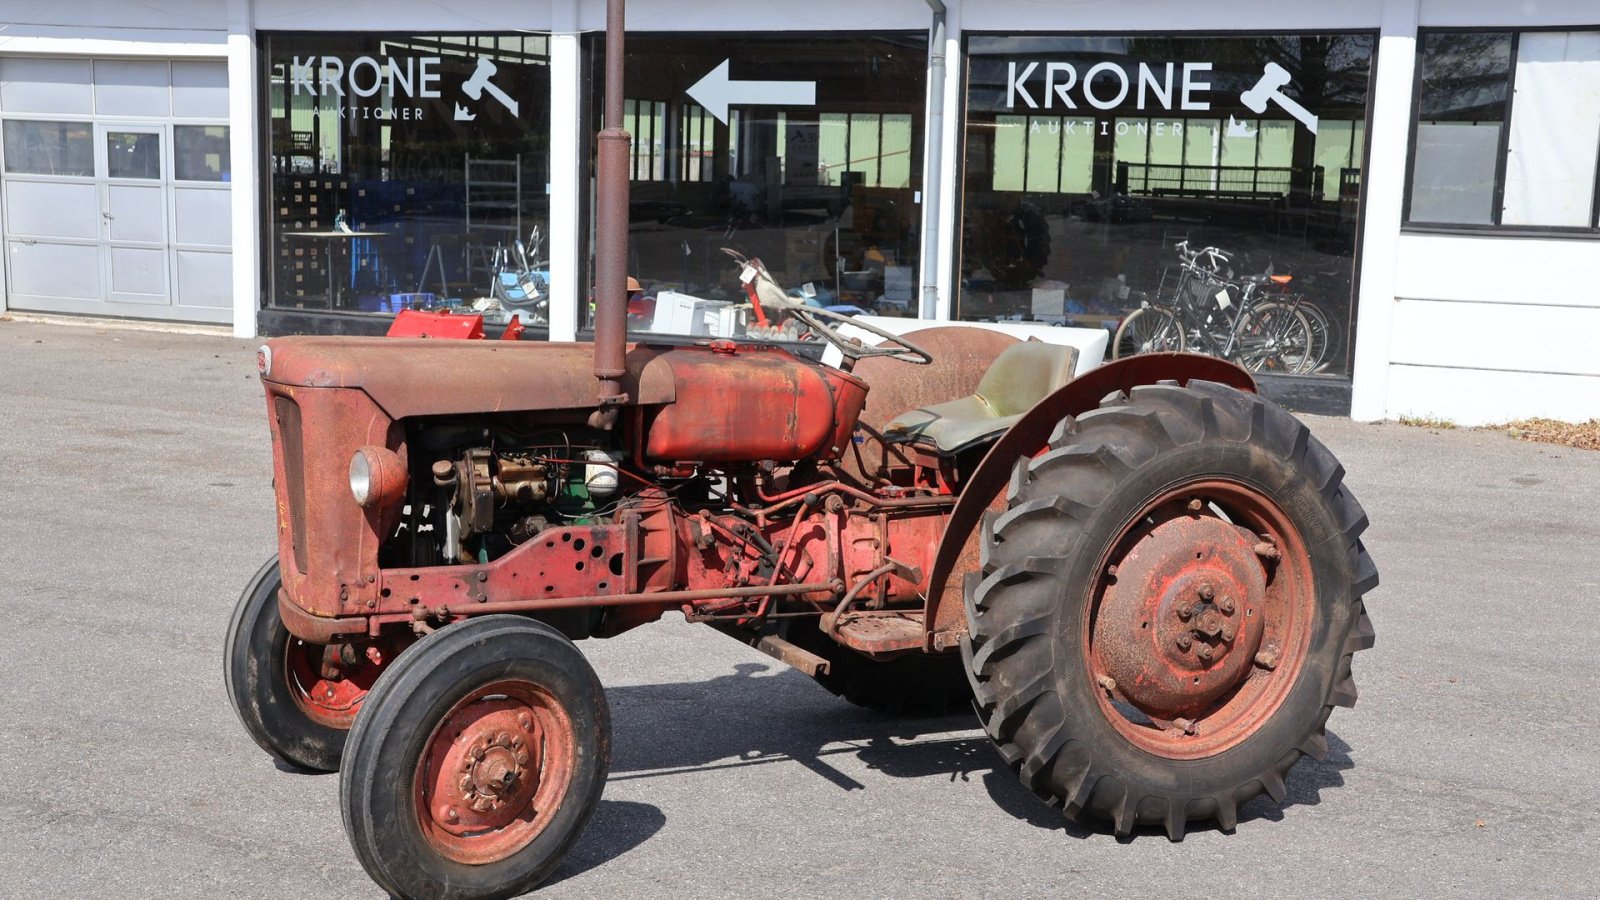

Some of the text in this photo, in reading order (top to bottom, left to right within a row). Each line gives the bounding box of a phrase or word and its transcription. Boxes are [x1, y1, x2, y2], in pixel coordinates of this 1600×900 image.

[293, 56, 441, 98] KRONE
[1006, 61, 1213, 110] KRONE
[1030, 120, 1183, 137] AUKTIONER
